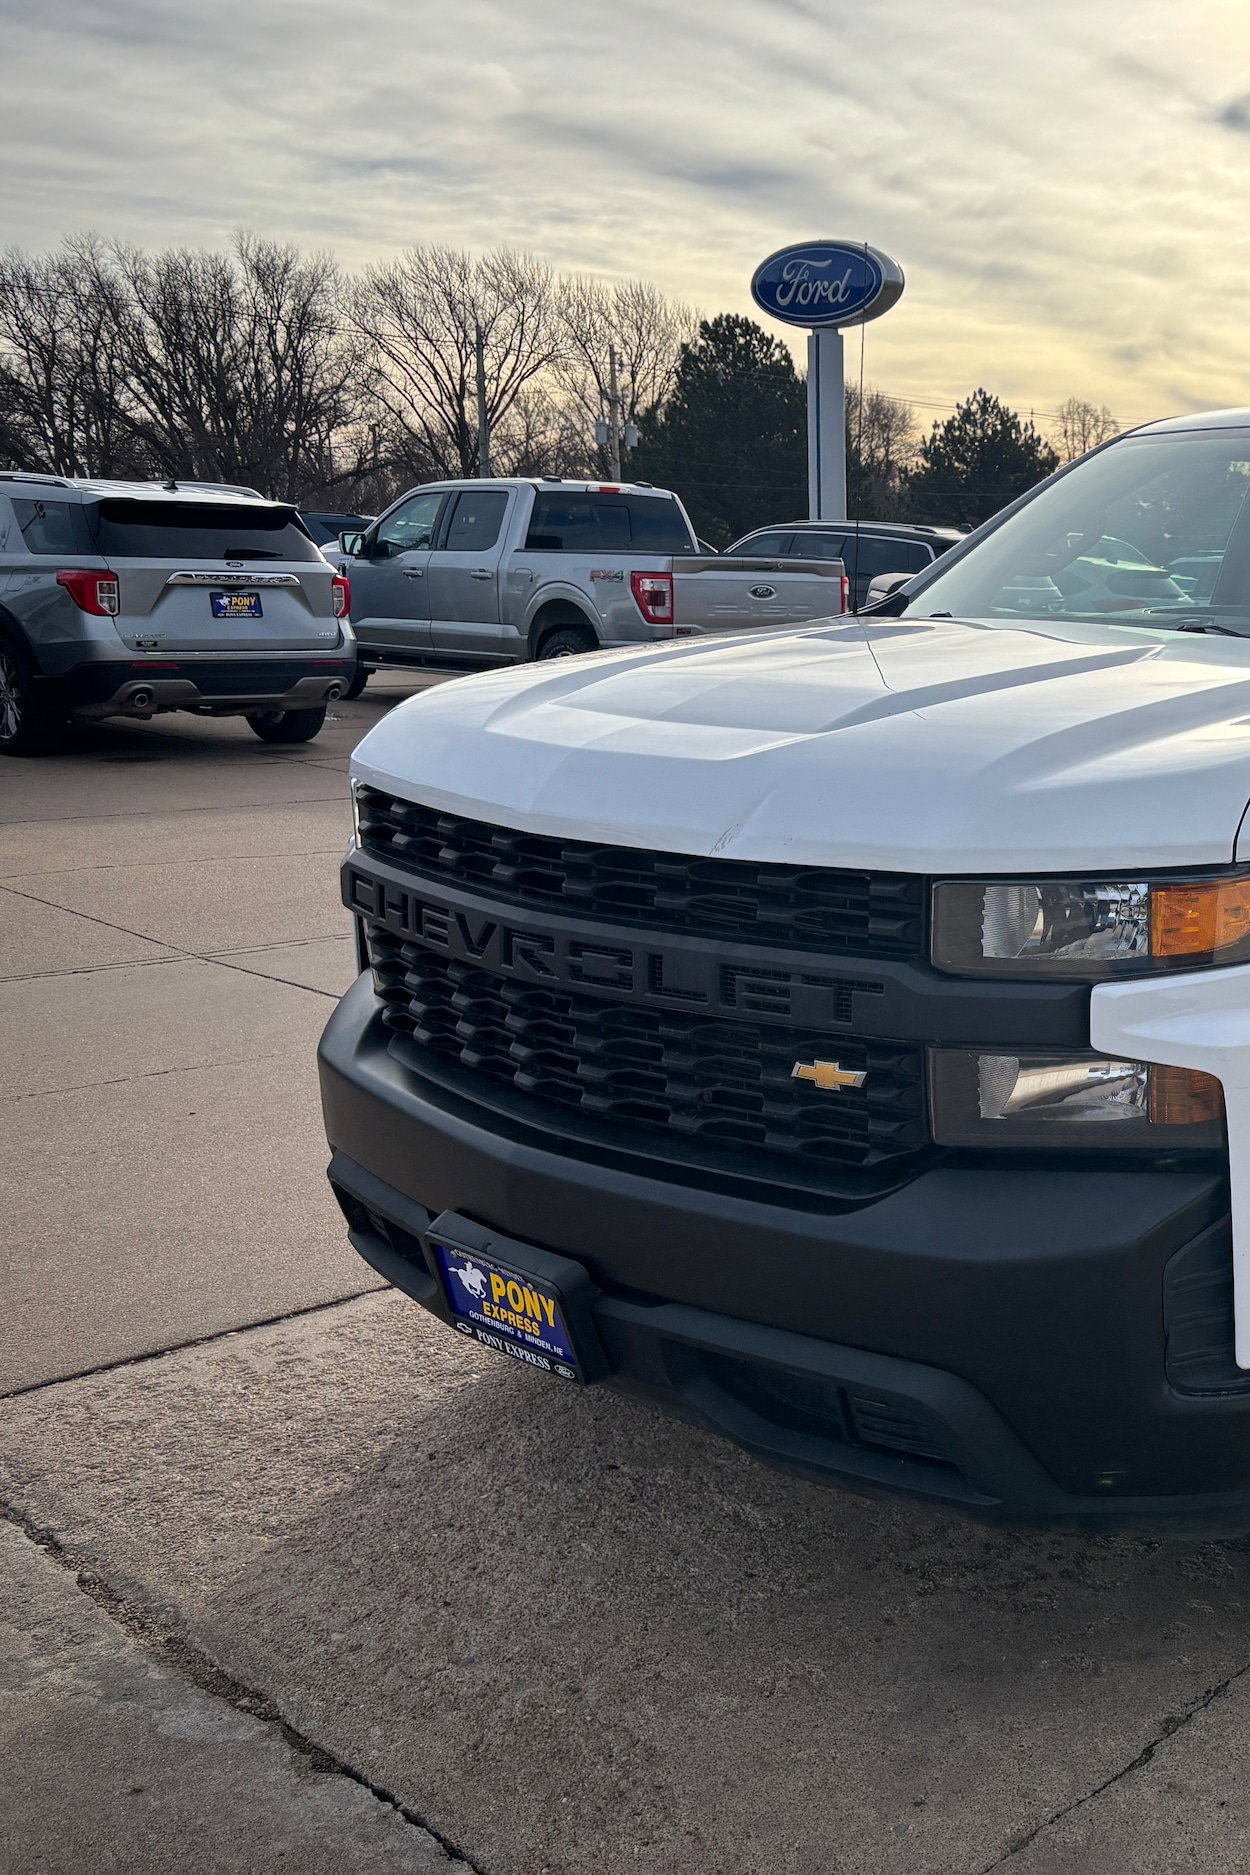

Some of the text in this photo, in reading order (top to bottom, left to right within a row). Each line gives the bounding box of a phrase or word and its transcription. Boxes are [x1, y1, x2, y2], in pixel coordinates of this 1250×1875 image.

[776, 259, 852, 306] Ford
[589, 569, 624, 582] FX4
[231, 596, 256, 606] PONY
[350, 869, 886, 1025] CHEVROLET
[482, 1300, 542, 1337] EXPRESS
[489, 1271, 555, 1328] PONY
[468, 1309, 515, 1336] GOTHENBURG
[516, 1330, 523, 1339] &
[475, 1328, 551, 1371] PONY EXPRESS
